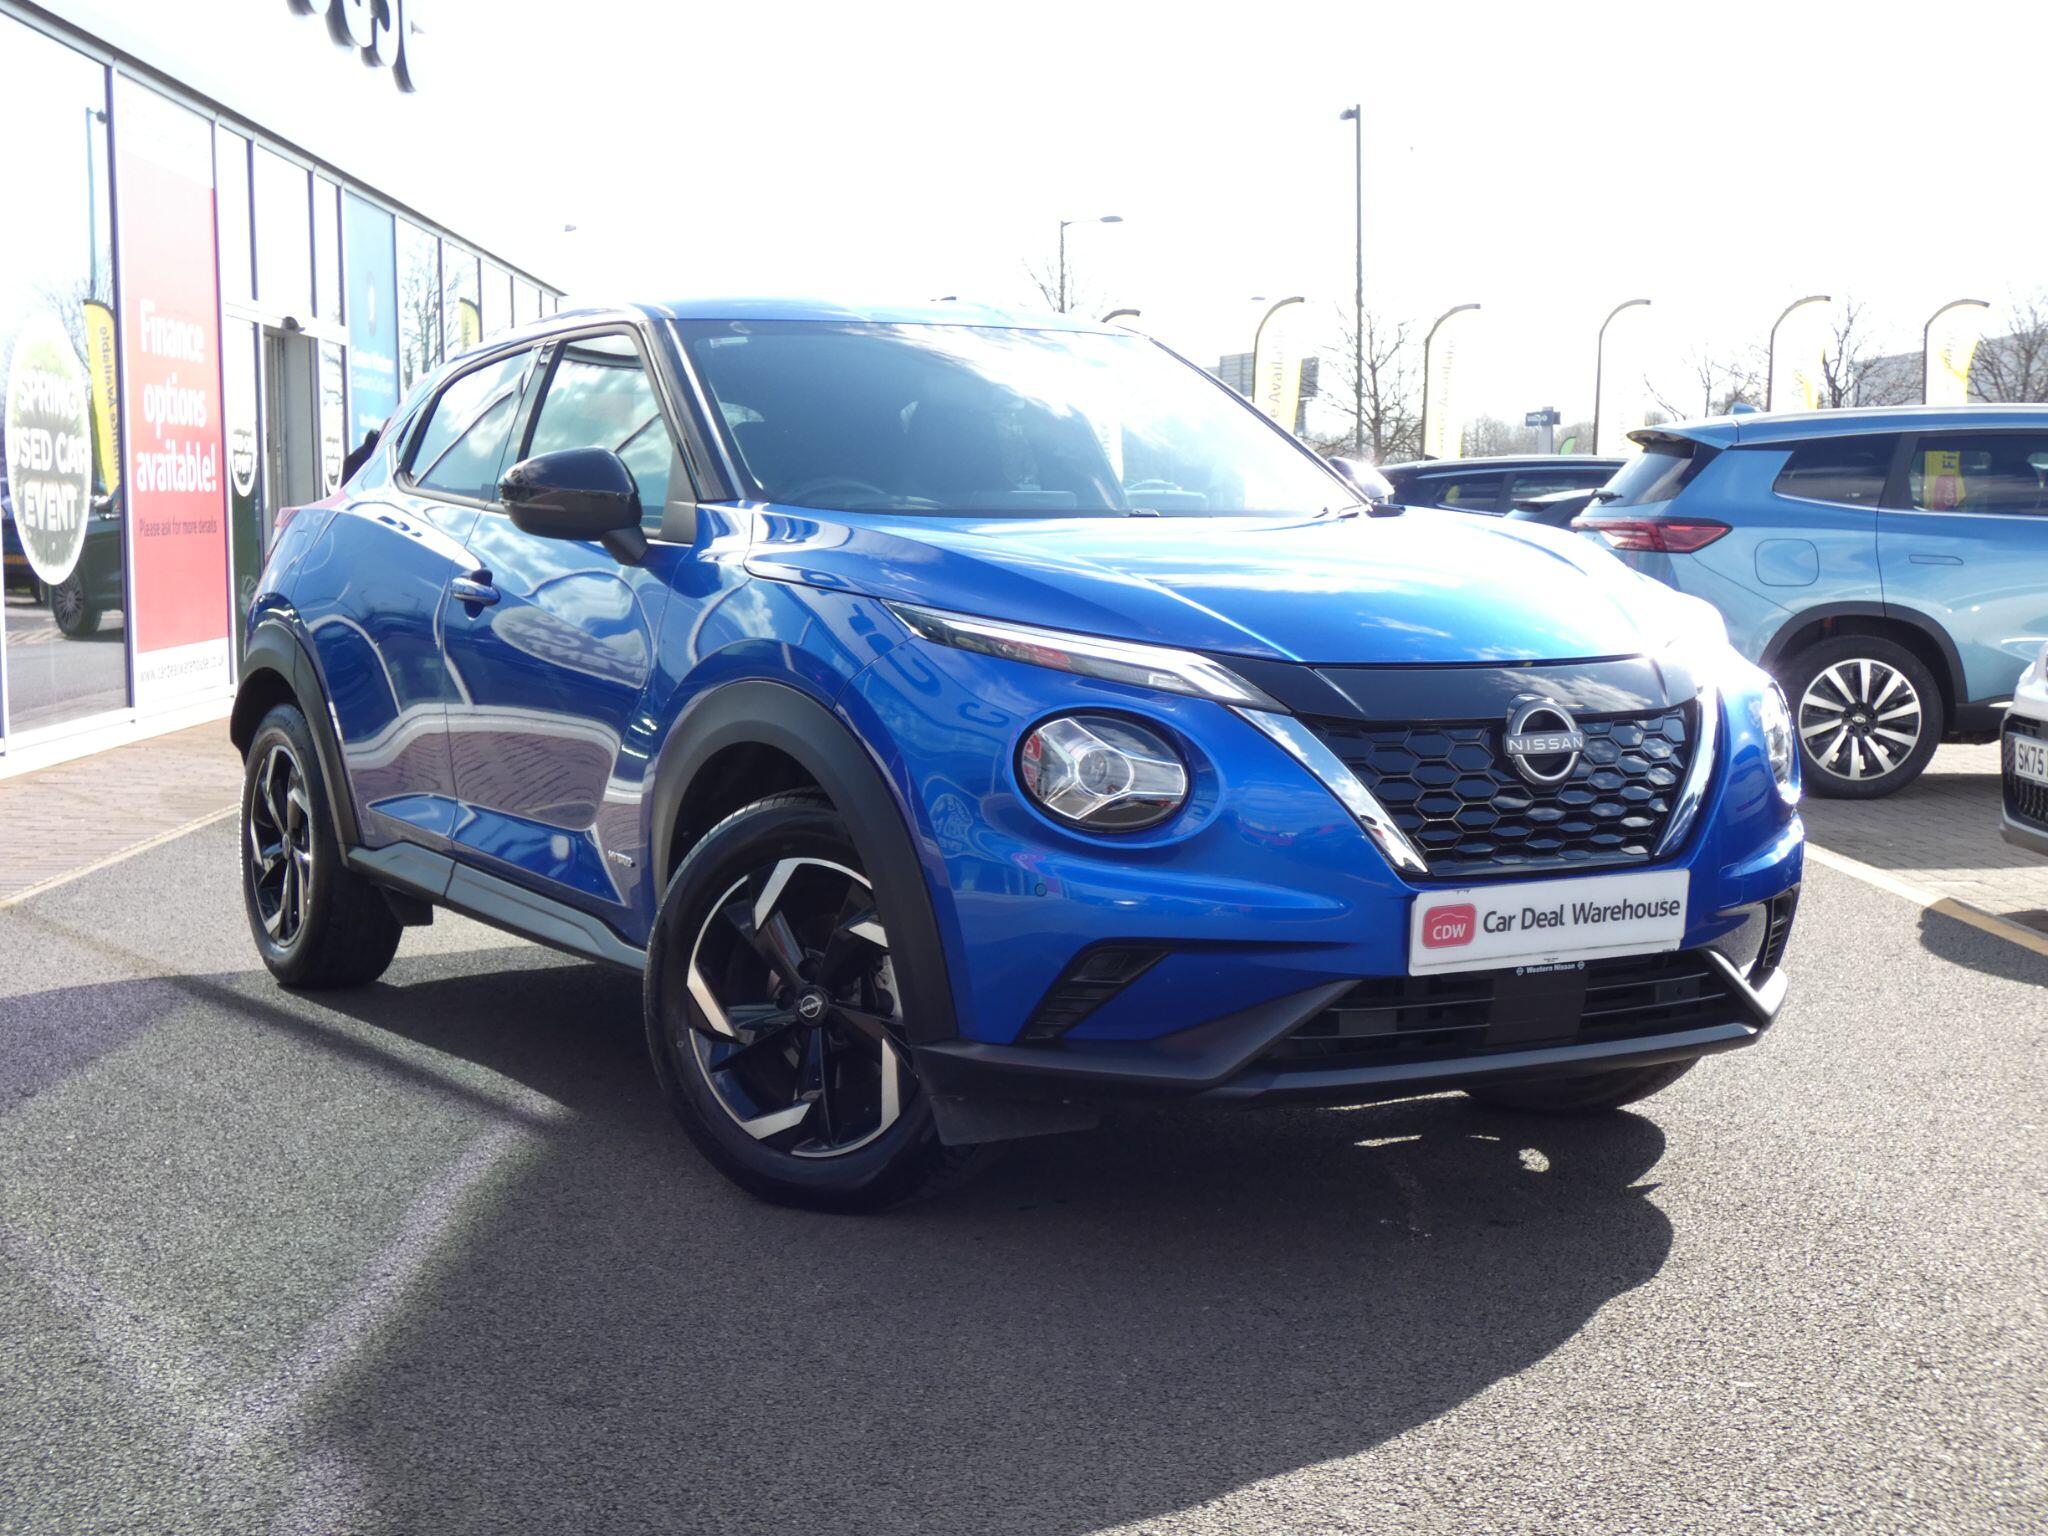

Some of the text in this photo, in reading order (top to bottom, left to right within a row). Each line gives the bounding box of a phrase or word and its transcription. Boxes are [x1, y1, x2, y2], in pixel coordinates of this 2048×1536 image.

[140, 299, 204, 363] Finance
[17, 369, 80, 421] SPRING
[144, 372, 207, 439] options
[136, 439, 217, 493] available!
[23, 481, 78, 533] EVENT
[1508, 735, 1584, 751] NISSAN
[2018, 743, 2044, 776] SK75
[1432, 922, 1467, 941] CDW
[1482, 897, 1681, 934] Car Deal Warehouse
[1526, 963, 1576, 974] Western Nissan
